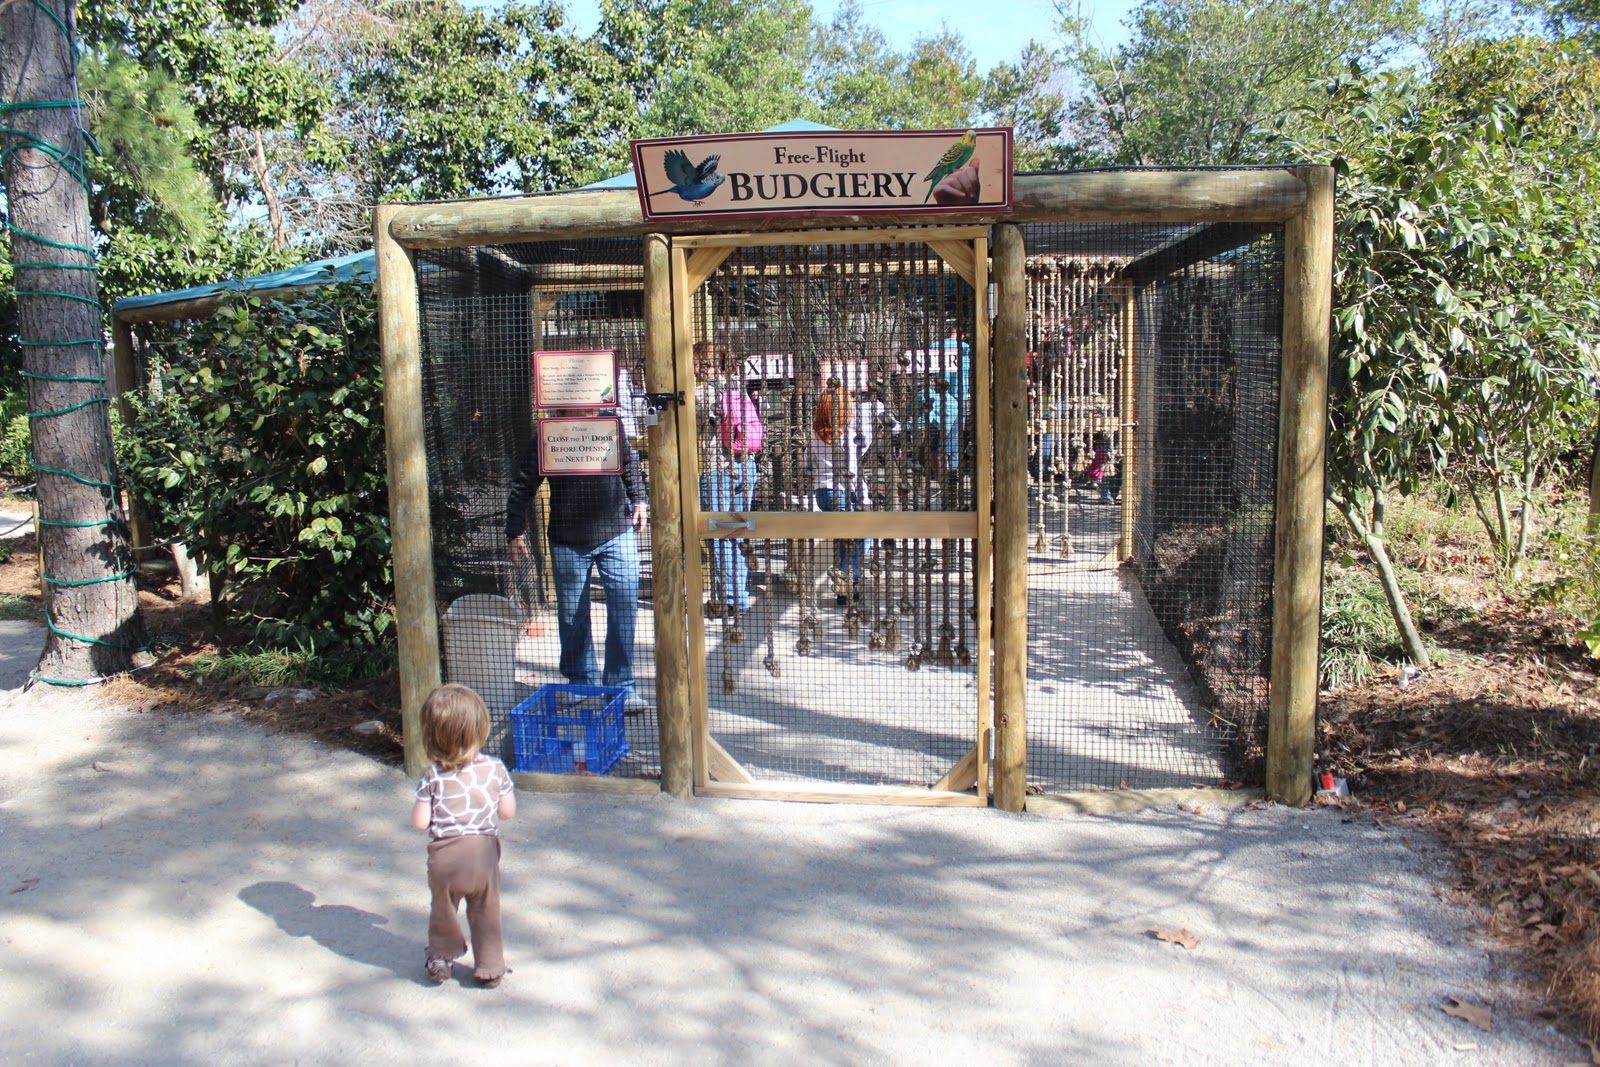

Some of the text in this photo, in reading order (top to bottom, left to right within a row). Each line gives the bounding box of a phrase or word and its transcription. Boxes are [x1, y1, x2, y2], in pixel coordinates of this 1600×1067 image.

[774, 146, 866, 167] Free-Flight
[728, 172, 917, 201] BUDGIERY
[733, 359, 786, 376] XT
[547, 435, 570, 443] CLOSE
[591, 434, 613, 442] DOOR
[550, 445, 611, 453] BEFORE OPENING
[565, 455, 585, 463] NEXT
[585, 455, 608, 463] DOOR
